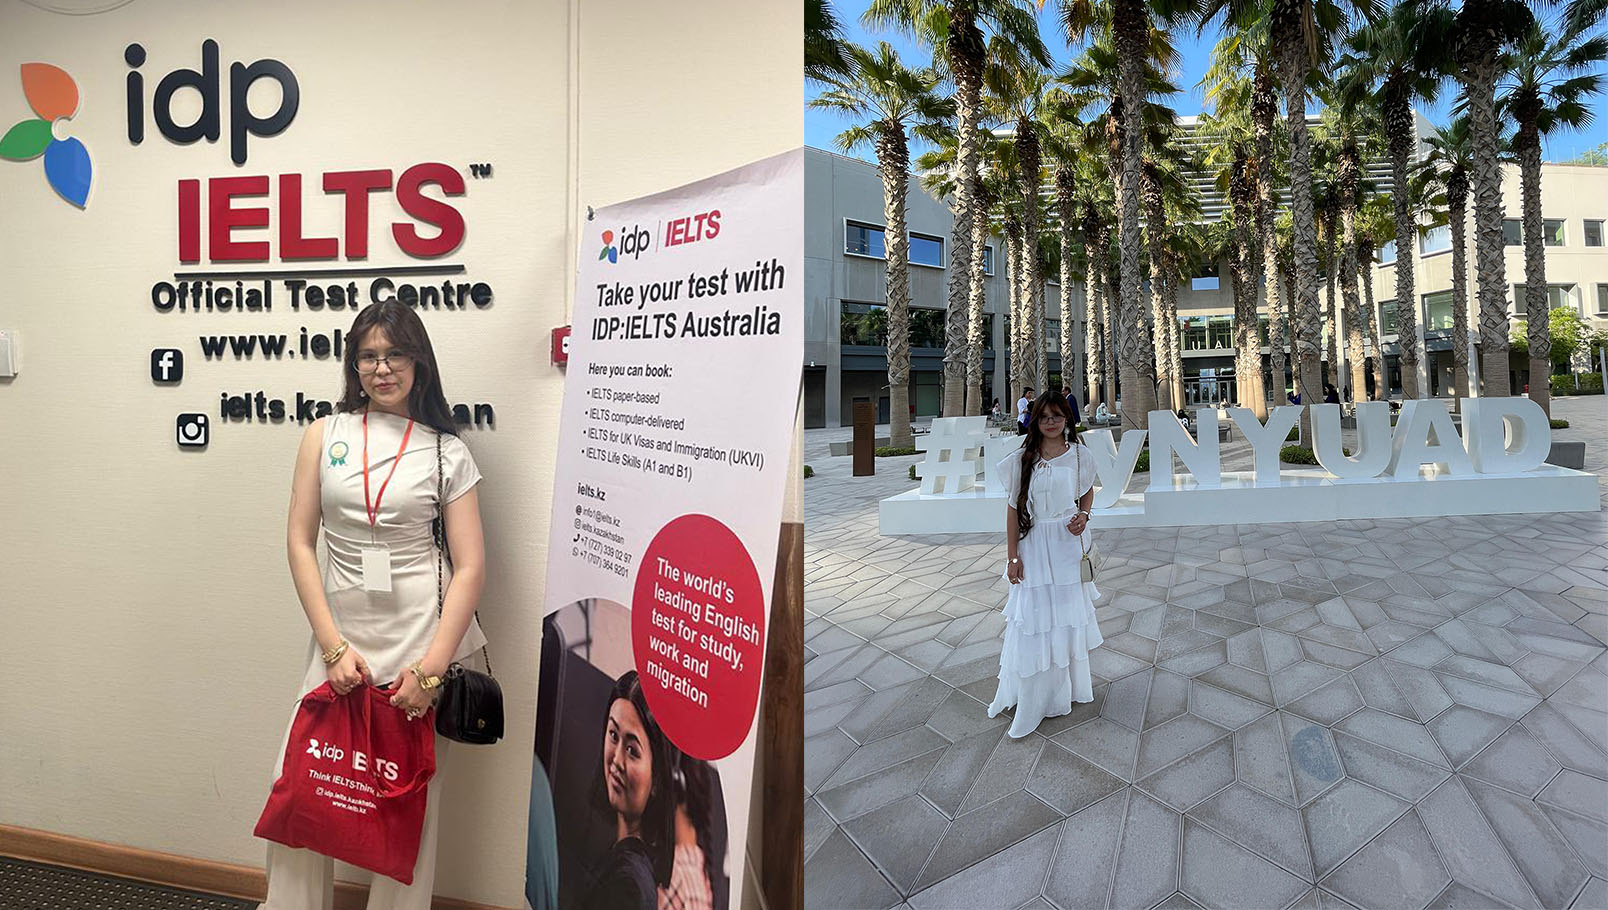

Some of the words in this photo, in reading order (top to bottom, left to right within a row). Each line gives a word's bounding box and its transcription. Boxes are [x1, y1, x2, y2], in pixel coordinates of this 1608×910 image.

[124, 38, 299, 165] idp
[178, 162, 466, 263] IELTS
[619, 224, 650, 260] idp
[665, 210, 721, 248] IELTS
[151, 280, 272, 311] Official
[285, 280, 358, 310] Test
[370, 278, 493, 310] Centre
[597, 282, 633, 308] Take
[638, 278, 683, 310] your
[688, 267, 728, 299] test
[735, 258, 785, 295] with
[592, 312, 677, 341] IDP:IELTS
[681, 305, 781, 339] Australia
[200, 327, 347, 360] www.iel
[588, 362, 607, 376] Here
[609, 365, 625, 378] you
[626, 366, 643, 377] can
[645, 364, 673, 378] book:
[591, 387, 612, 401] IELTS
[613, 390, 660, 404] paper-based
[589, 408, 610, 421] IELTS
[611, 411, 685, 431] computer-delivered
[586, 447, 607, 462] IELTS
[607, 451, 620, 465] Life
[621, 453, 641, 469] Skills
[643, 456, 657, 473] (A1
[658, 462, 674, 476] and
[676, 464, 692, 482] B1)
[587, 427, 608, 442] IELTS
[609, 431, 619, 443] for
[620, 433, 632, 446] UK
[633, 434, 655, 449] Visas
[656, 438, 672, 452] and
[674, 440, 726, 462] Immigration
[728, 449, 765, 471] (UKVI)
[577, 482, 606, 501] ielts.kz
[657, 556, 680, 582] The
[654, 582, 701, 622] leading
[705, 603, 760, 646] English
[649, 635, 679, 663] work
[682, 653, 709, 679] and
[651, 607, 676, 634] test
[678, 620, 697, 643] for
[700, 633, 743, 671] study,
[646, 660, 708, 708] migration
[308, 769, 331, 782] Think
[322, 742, 344, 763] idp
[352, 750, 399, 781] IETS
